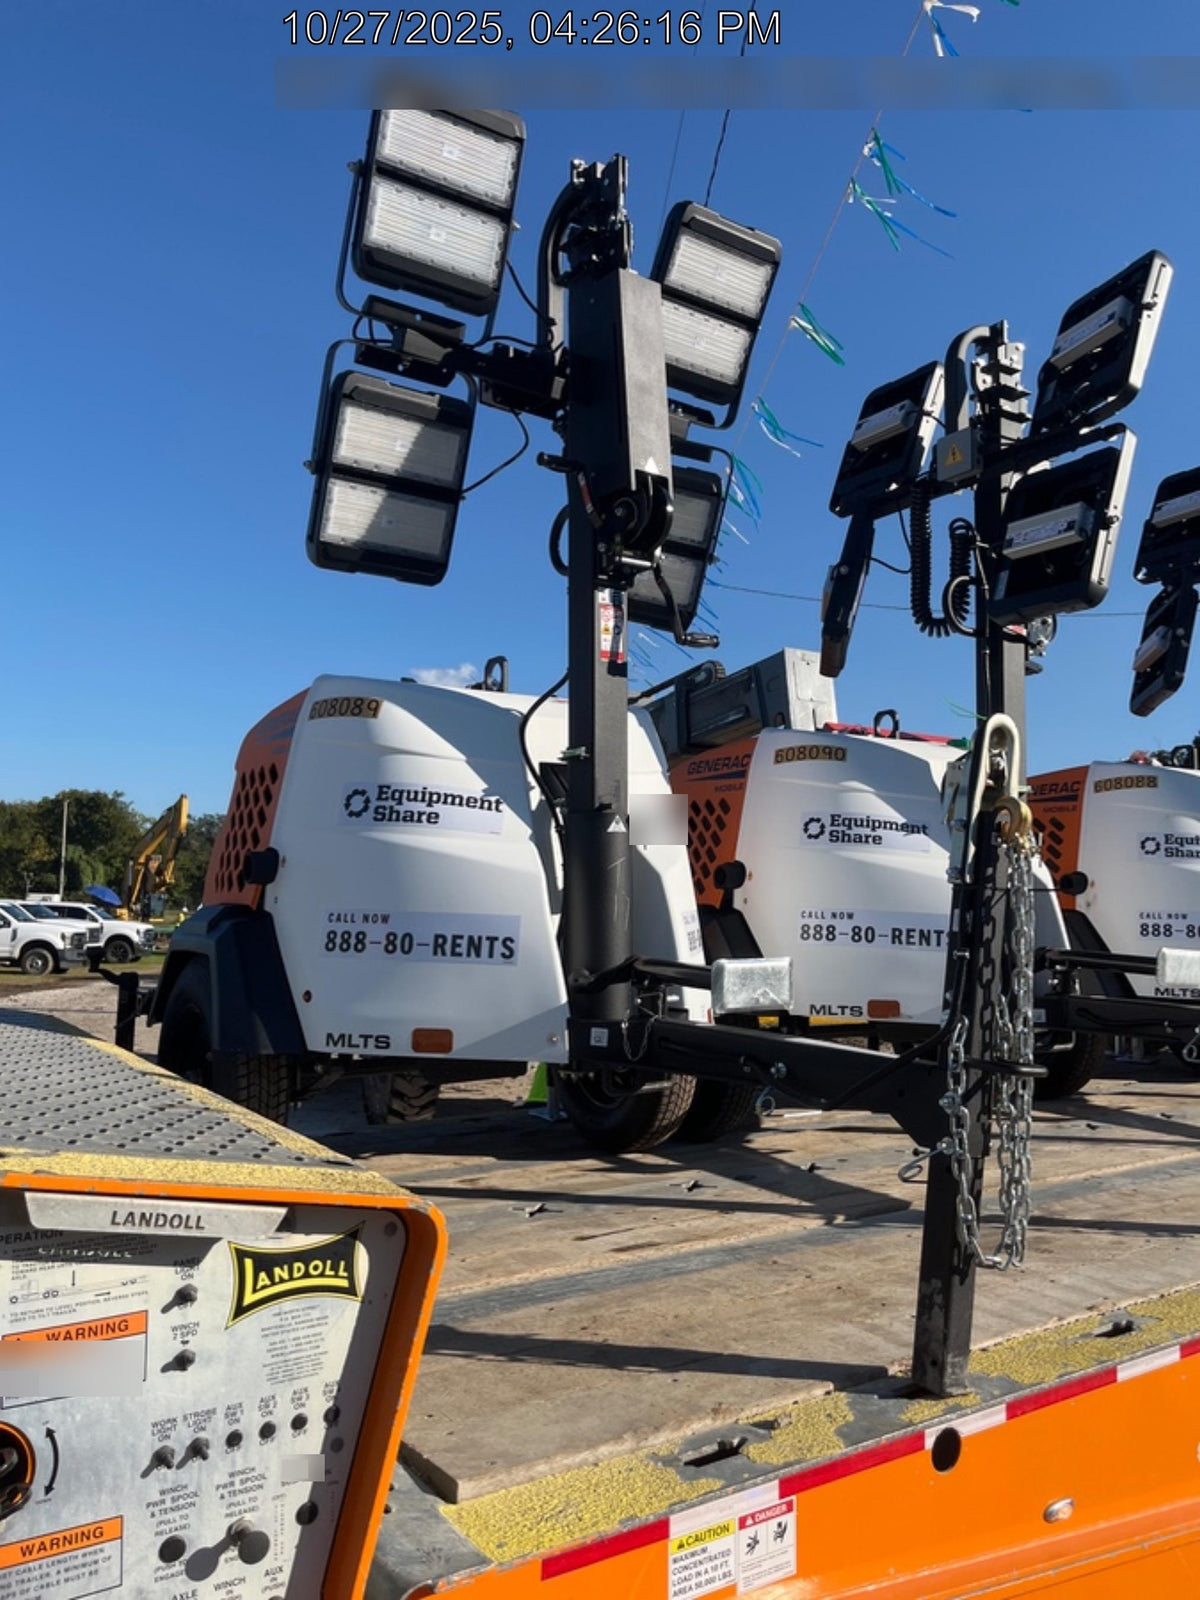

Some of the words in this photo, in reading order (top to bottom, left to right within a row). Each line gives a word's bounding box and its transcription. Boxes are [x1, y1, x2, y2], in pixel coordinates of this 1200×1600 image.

[310, 697, 382, 719] 608089
[775, 745, 847, 763] 608090
[687, 755, 751, 775] GENERAC
[1094, 776, 1158, 793] 608088
[376, 785, 503, 813] Equipment
[373, 805, 440, 824] Share
[829, 814, 928, 835] Equipment
[828, 830, 882, 845] Share
[328, 913, 356, 923] CALL
[362, 914, 390, 924] NOW
[801, 911, 826, 919] CALL
[831, 912, 854, 920] NOW
[1140, 912, 1162, 920] CALL
[800, 923, 950, 947] 888-80-RENT
[325, 929, 515, 959] 888-80-RENTS
[809, 1004, 864, 1016] MLTS
[326, 1033, 390, 1049] MLTS
[110, 1210, 206, 1230] LANDOLL
[243, 1258, 349, 1306] LANDOLL
[171, 1321, 199, 1332] WINCH
[180, 1329, 197, 1338] SPD
[182, 1407, 217, 1422] STROBE
[187, 1415, 212, 1428] LIGHT
[227, 1417, 240, 1426] ON
[151, 1417, 178, 1428] WORK
[152, 1423, 177, 1437] LIGHT
[193, 1425, 206, 1433] ON
[157, 1433, 171, 1442] ON
[228, 1466, 256, 1478] WINCH
[215, 1480, 235, 1491] PWR
[240, 1473, 267, 1485] SPOOL
[159, 1484, 188, 1496] WINCH
[227, 1483, 264, 1498] TENSION
[145, 1498, 166, 1509] PWR
[170, 1490, 200, 1504] SPOOL
[158, 1501, 196, 1515] TENSION
[20, 1526, 104, 1557] WARNING
[686, 1523, 730, 1546] CAUTION
[15, 1564, 42, 1576] CABLE
[46, 1555, 79, 1568] LENGTH
[264, 1565, 285, 1577] AUX
[20, 1587, 30, 1595] OF
[33, 1580, 61, 1592] CABLE
[64, 1571, 86, 1583] MUST
[213, 1576, 246, 1591] WINCH
